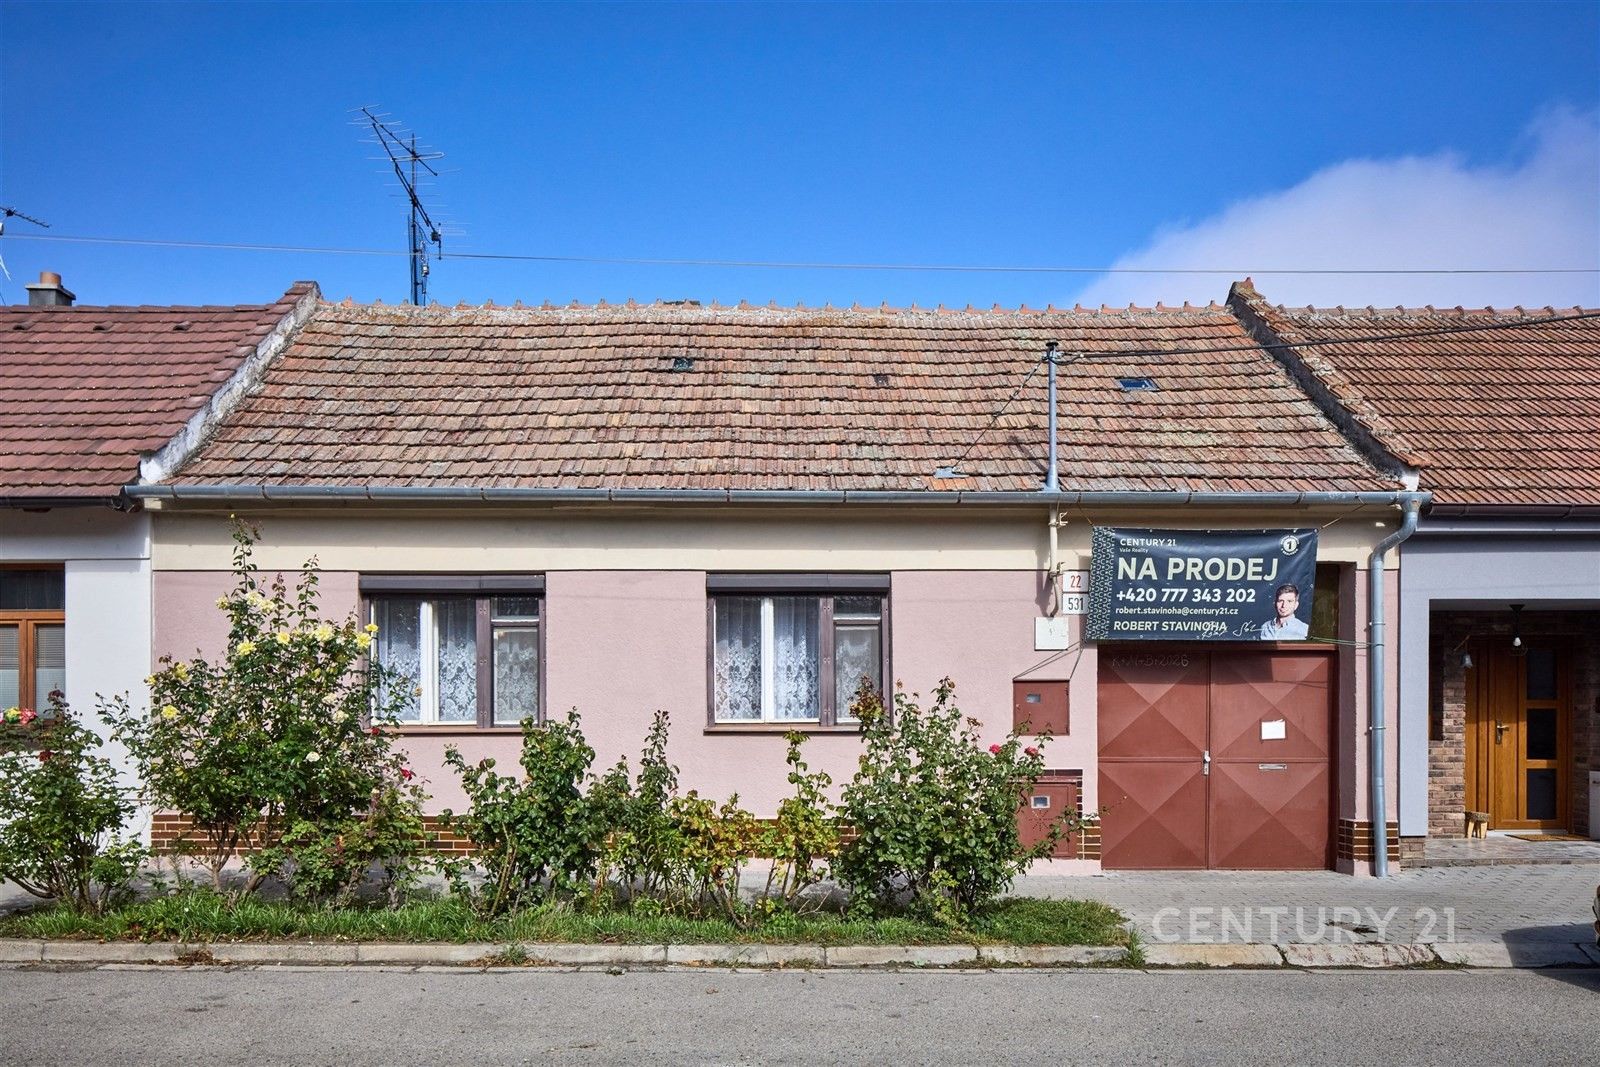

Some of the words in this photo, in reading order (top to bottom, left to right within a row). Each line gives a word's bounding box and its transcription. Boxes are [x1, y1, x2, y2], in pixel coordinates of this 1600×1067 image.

[1120, 538, 1165, 547] CENTURY
[1167, 538, 1176, 547] 21
[1117, 557, 1158, 581] NA
[1167, 557, 1279, 581] PRODEJ
[1070, 575, 1082, 588] 22
[1116, 588, 1157, 602] +420
[1161, 588, 1188, 602] 777
[1191, 588, 1221, 602] 343
[1225, 588, 1256, 603] 202
[1068, 597, 1084, 611] 531
[1115, 606, 1239, 616] robert.stavinoha@century21.cz
[1113, 621, 1160, 631] ROBERT
[1161, 621, 1227, 632] STAVINOHA
